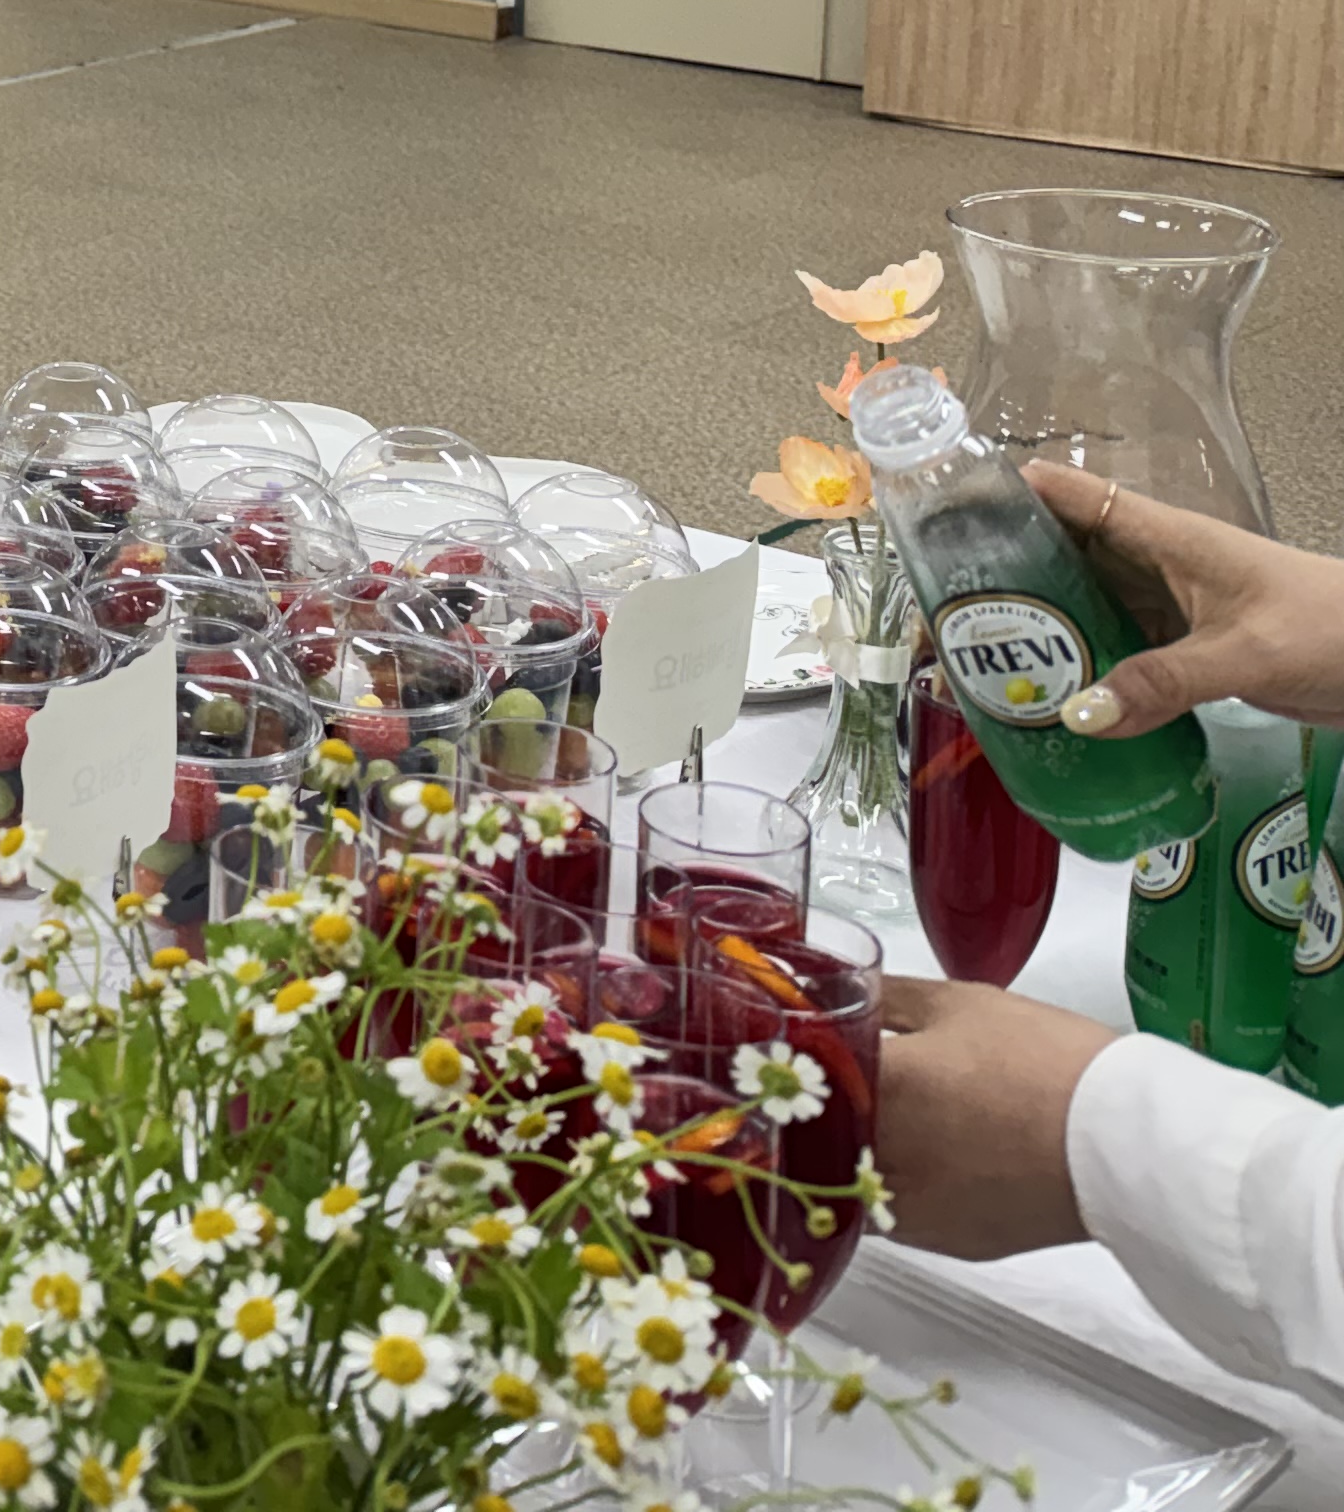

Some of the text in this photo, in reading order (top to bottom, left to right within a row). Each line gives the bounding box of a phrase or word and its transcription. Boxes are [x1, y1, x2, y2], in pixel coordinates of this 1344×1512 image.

[973, 604, 1047, 627] SPARKLING
[949, 634, 1075, 677] TREVI
[1252, 839, 1310, 888] TRE
